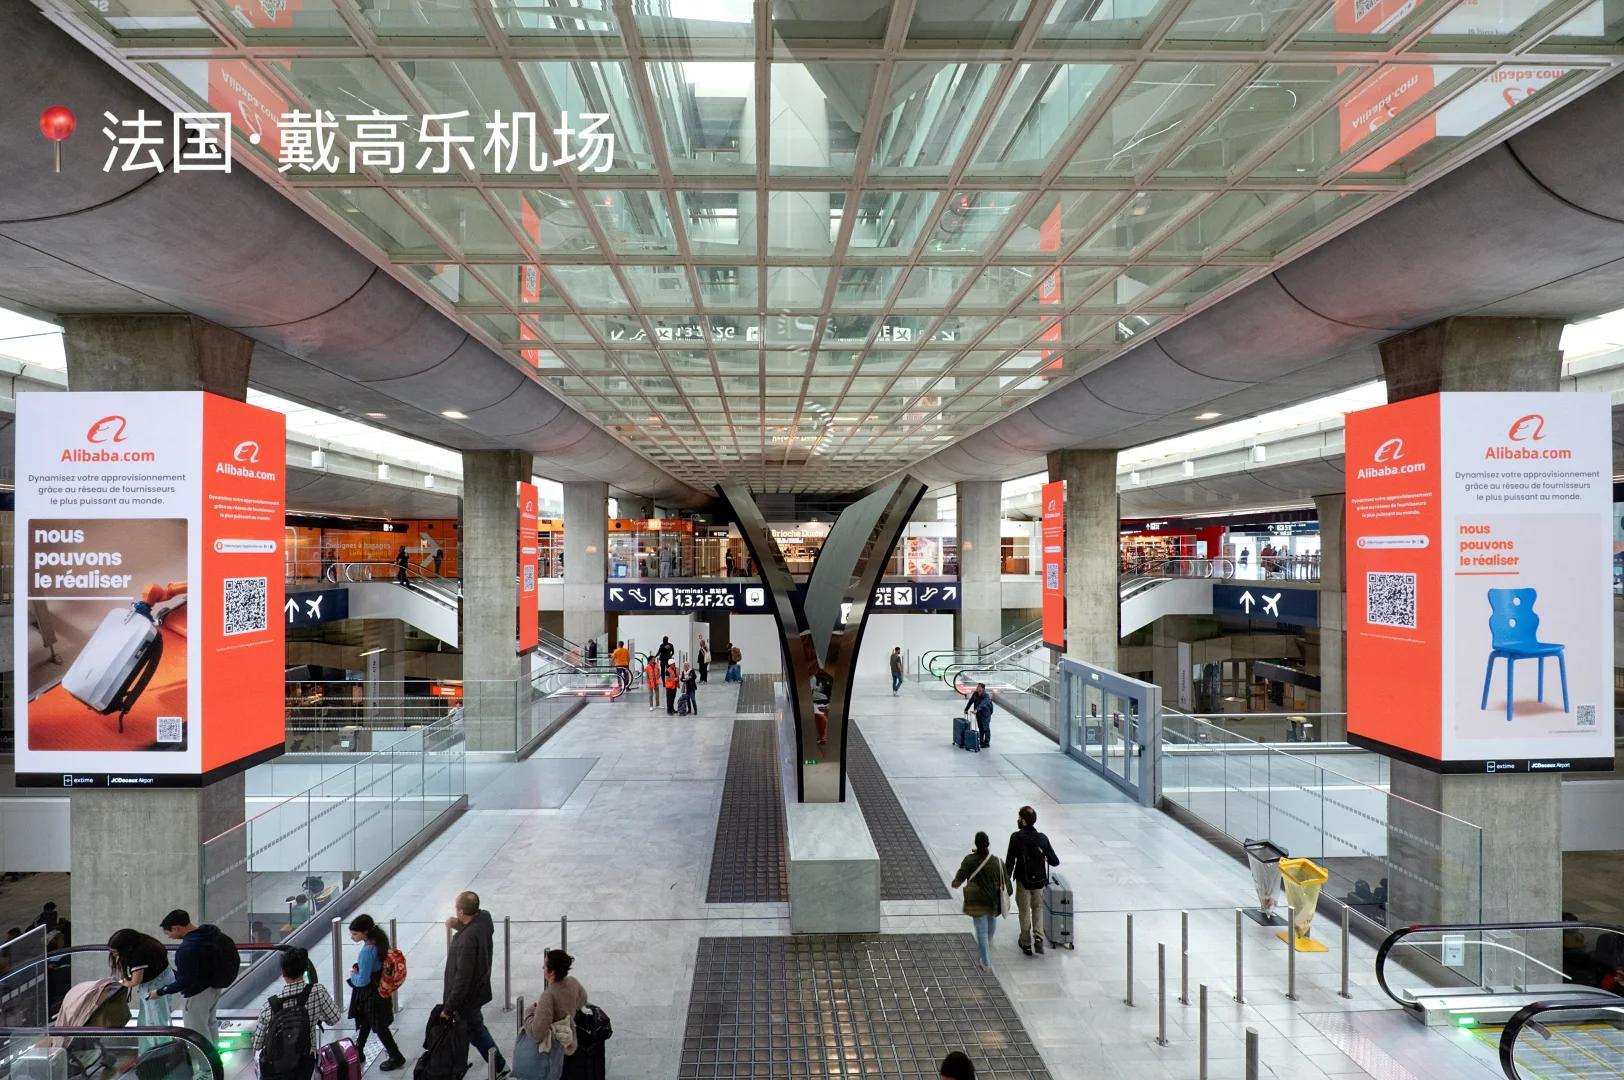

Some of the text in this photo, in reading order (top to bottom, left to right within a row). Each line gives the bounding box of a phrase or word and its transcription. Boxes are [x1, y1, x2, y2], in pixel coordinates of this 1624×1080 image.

[60, 448, 154, 462] Alibaba.com
[1484, 446, 1572, 459] Alibaba.com
[216, 462, 275, 481] Alibaba.com
[1357, 462, 1425, 479] Alibaba.com
[1455, 471, 1499, 480] Dynamisez
[1523, 470, 1600, 479] approvisionnement
[28, 474, 74, 483] Dynamisez
[101, 474, 185, 483] approvisionnement
[38, 485, 63, 495] grâce
[1464, 482, 1488, 491] grâce
[59, 497, 77, 506] plus
[79, 497, 116, 506] puissant
[1485, 493, 1502, 502] plus
[1504, 493, 1538, 502] puissant
[772, 529, 800, 537] Brioche
[1460, 524, 1490, 534] nous
[34, 528, 84, 543] nous
[1460, 540, 1513, 552] pouvons
[34, 551, 122, 569] pouvons
[1460, 554, 1519, 565] le réaliser
[34, 570, 131, 588] le réaliser
[675, 595, 734, 607] 1,3,2F,2G
[875, 594, 892, 605] 2E
